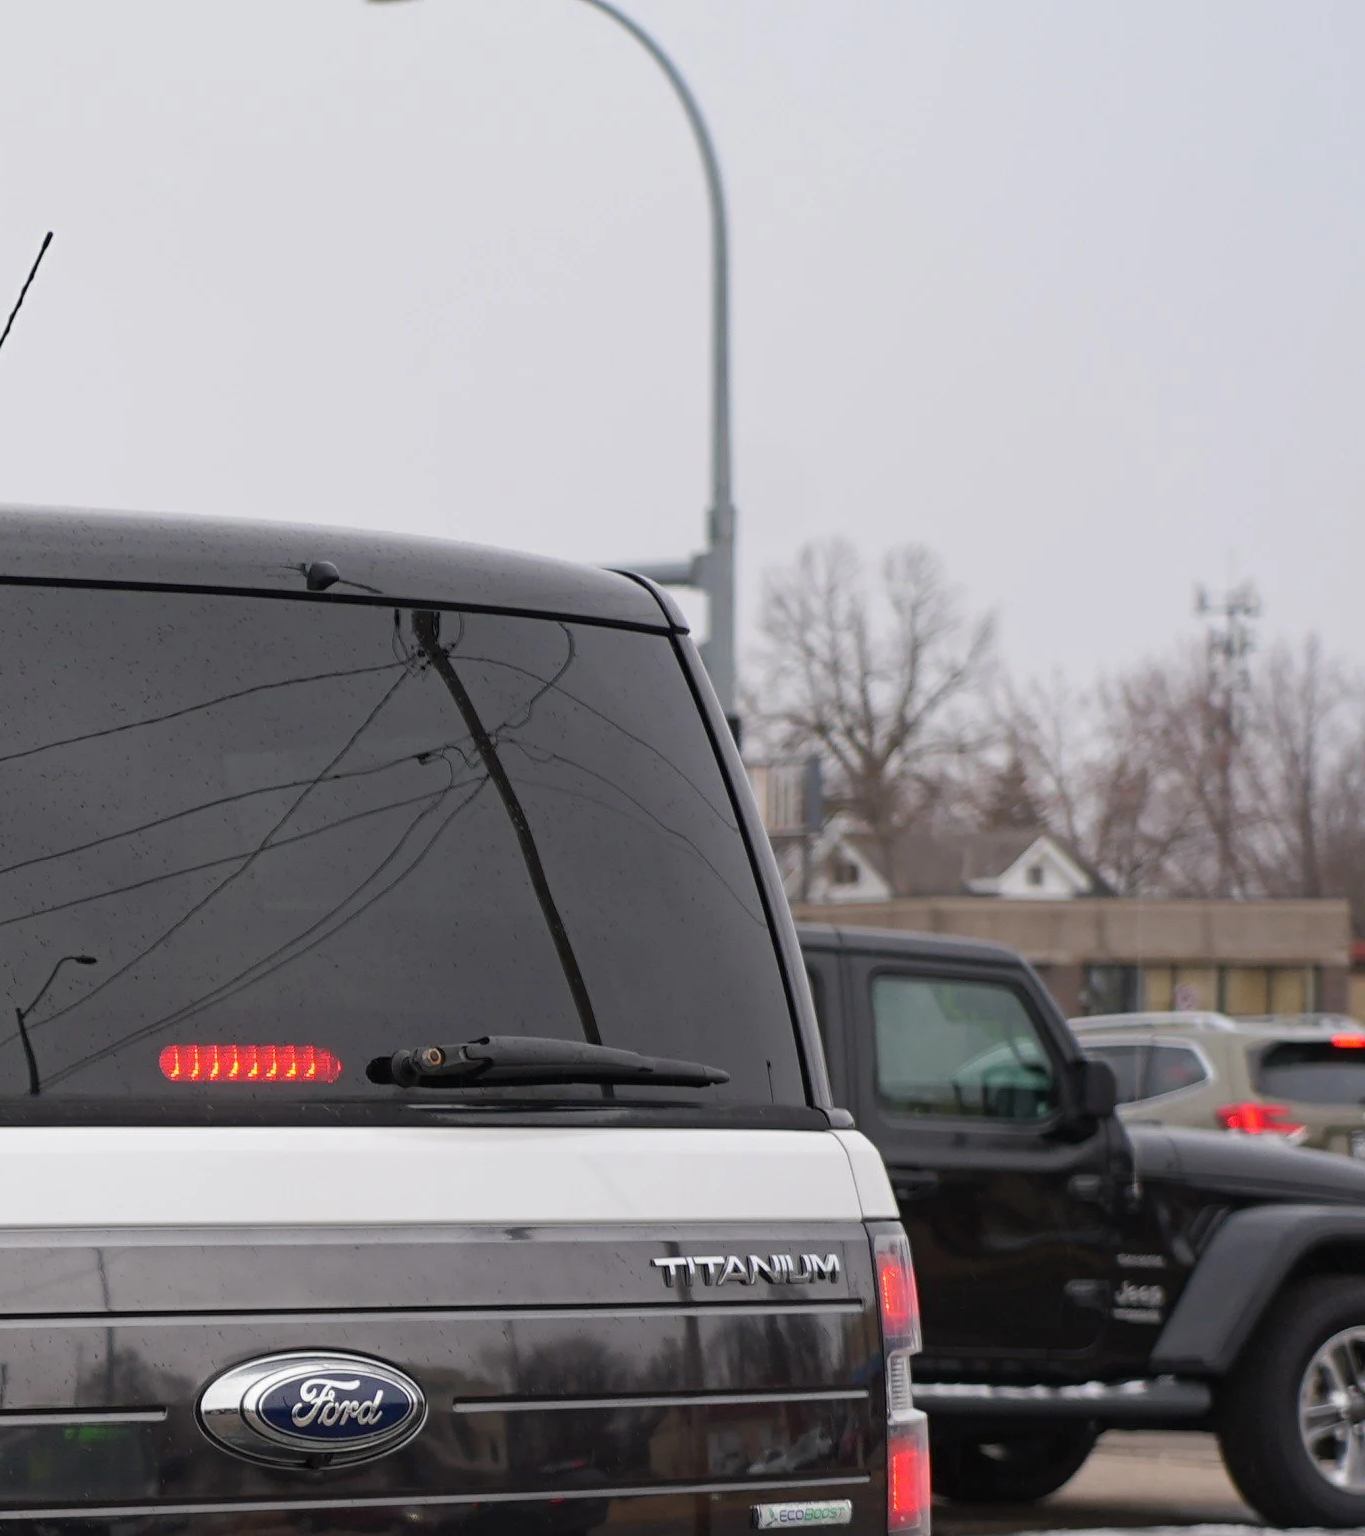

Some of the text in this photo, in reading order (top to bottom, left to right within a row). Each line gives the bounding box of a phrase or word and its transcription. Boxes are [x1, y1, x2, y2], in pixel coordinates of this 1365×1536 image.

[649, 1252, 841, 1288] TITANIUM
[1114, 1280, 1165, 1307] Jeep
[291, 1378, 384, 1428] Ford
